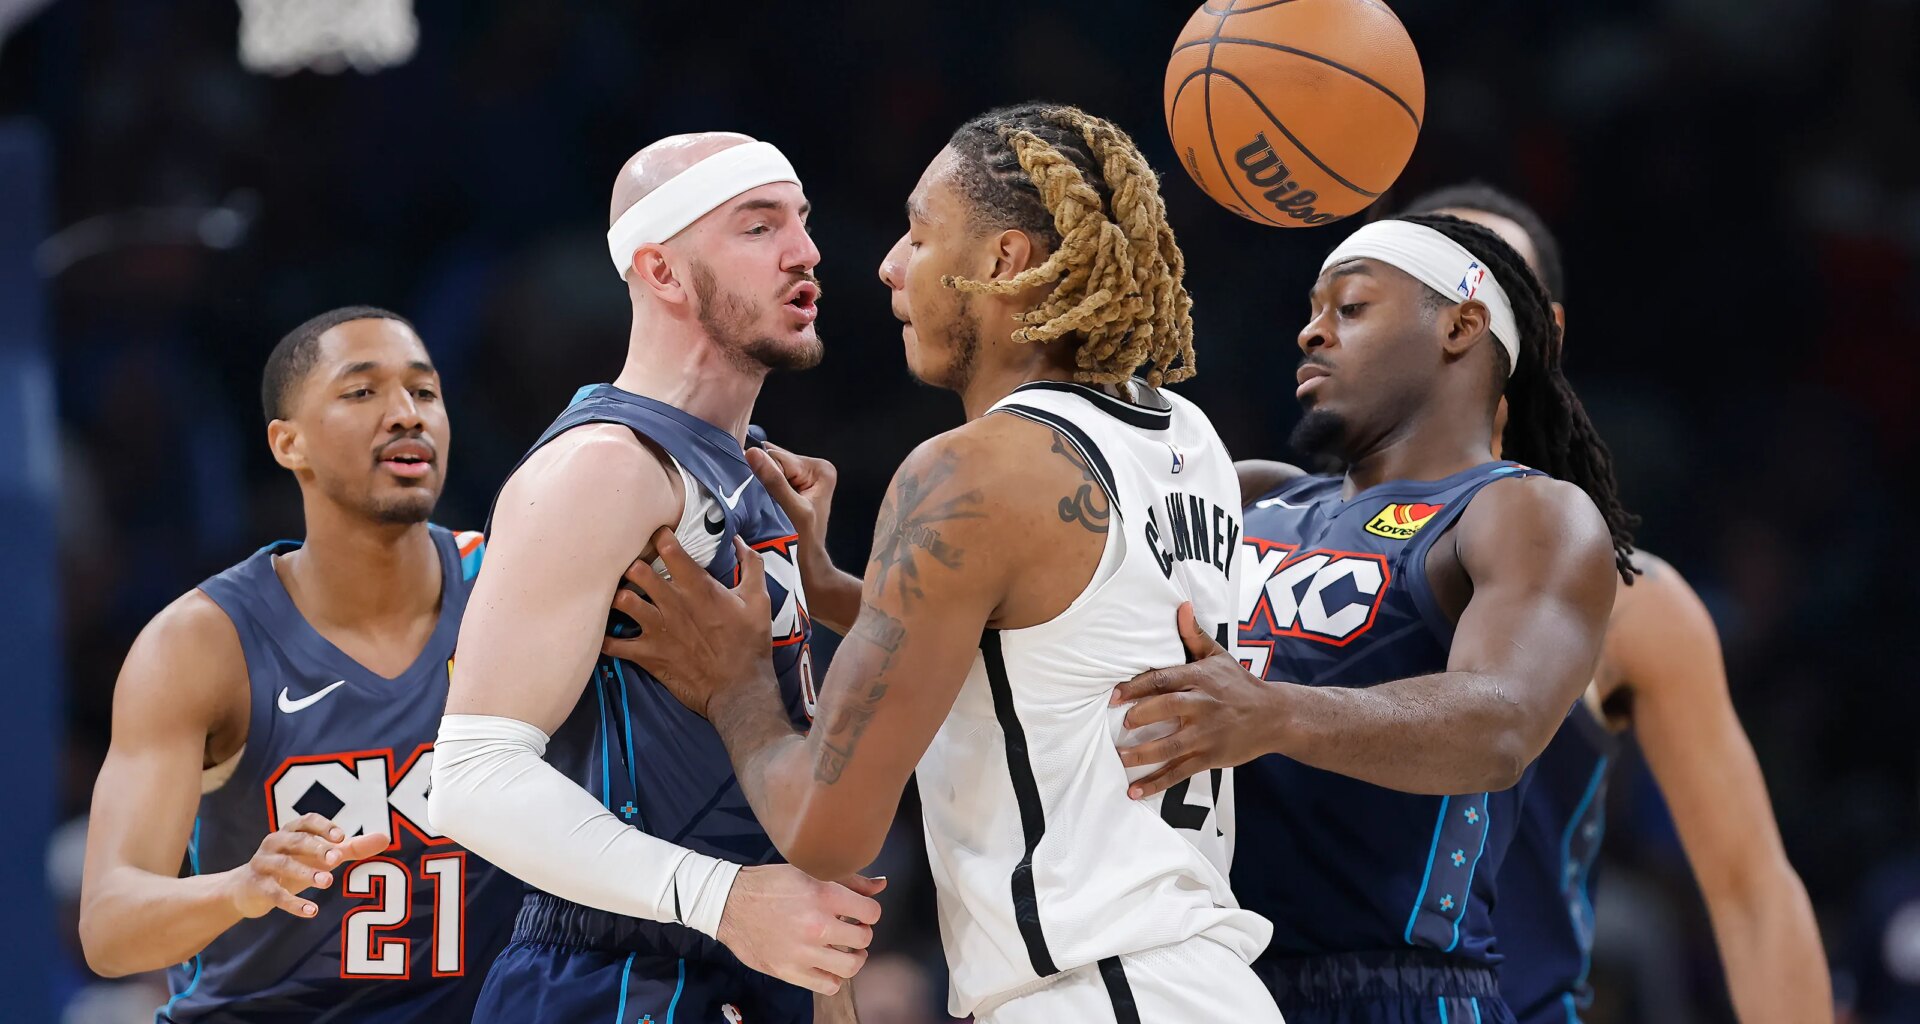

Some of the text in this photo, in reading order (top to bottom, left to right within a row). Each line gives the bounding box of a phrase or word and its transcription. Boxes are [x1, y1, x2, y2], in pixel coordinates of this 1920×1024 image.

[1234, 131, 1346, 224] Wilso
[1238, 537, 1392, 647] KC
[264, 742, 447, 851] OK
[340, 851, 466, 980] 21
